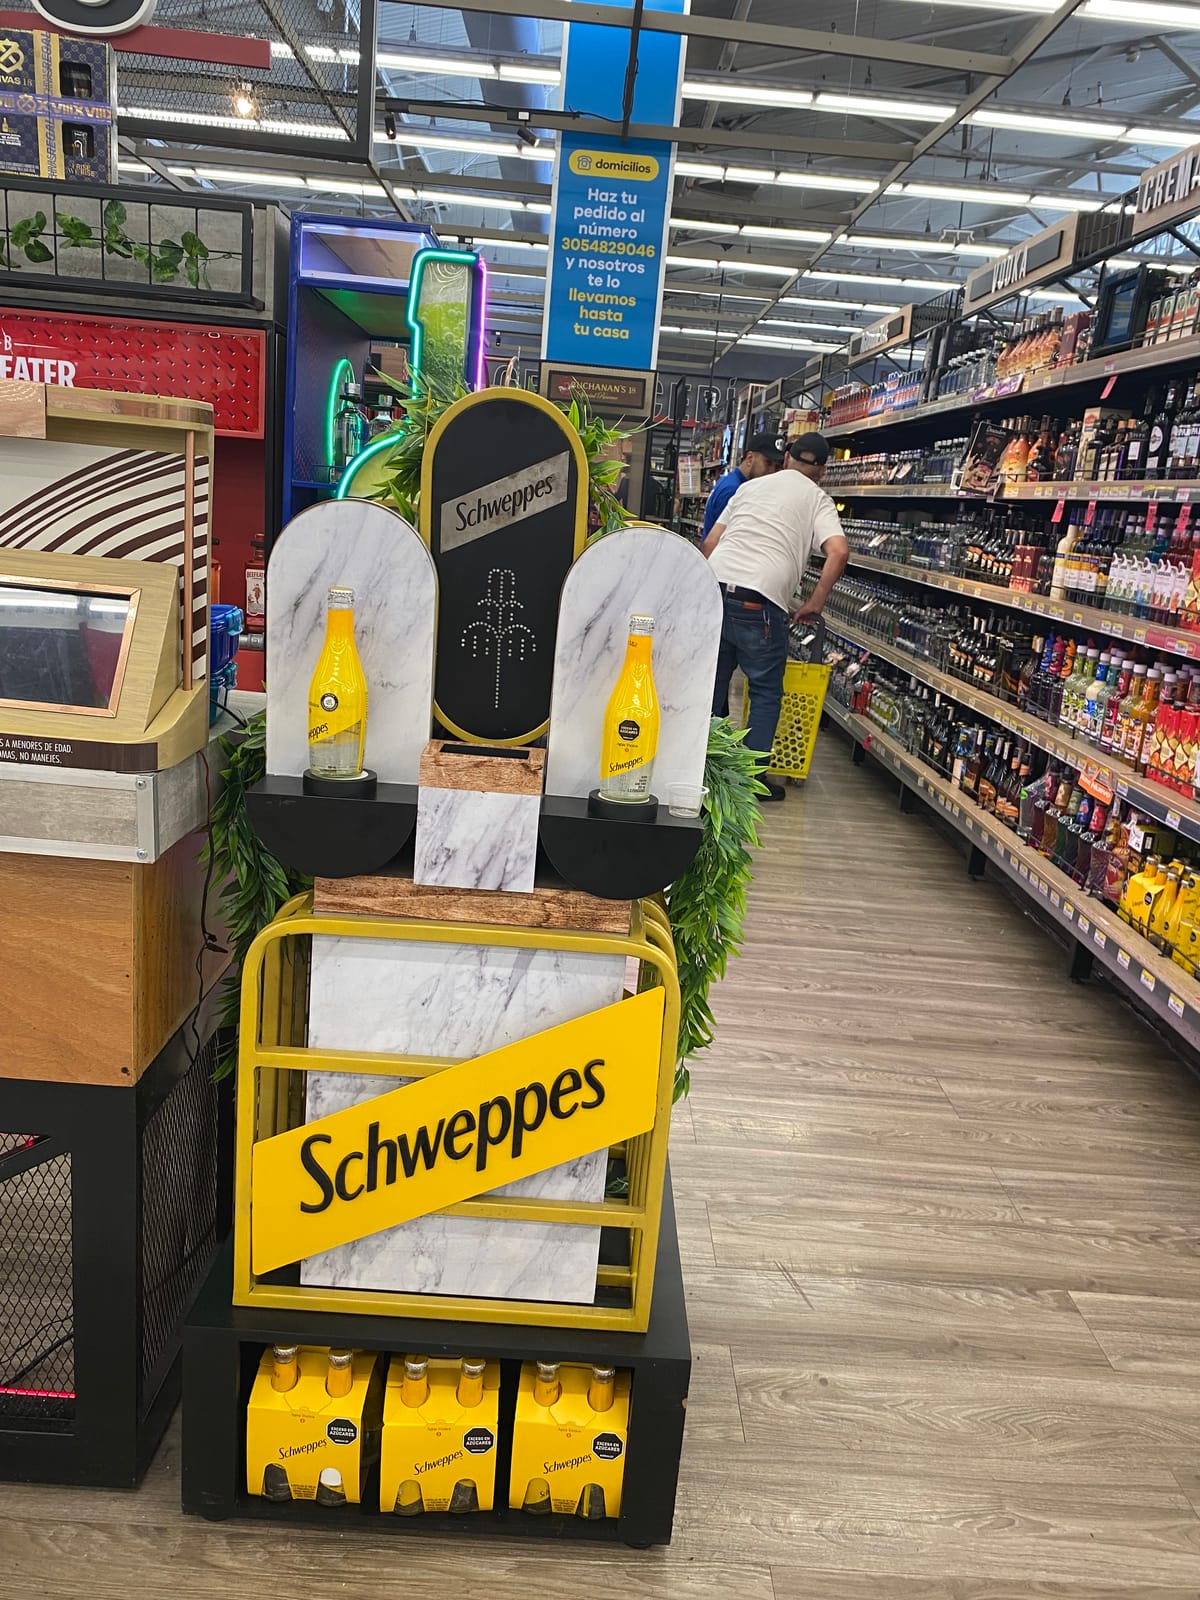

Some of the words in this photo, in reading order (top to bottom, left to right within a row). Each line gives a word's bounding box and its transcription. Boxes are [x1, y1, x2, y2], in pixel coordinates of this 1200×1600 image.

[595, 159, 651, 174] domicilios
[587, 188, 618, 204] Haz
[621, 191, 637, 204] tu
[574, 205, 627, 222] pedido
[630, 209, 645, 222] al
[578, 222, 638, 239] número
[561, 237, 655, 257] 3054829046
[565, 256, 575, 270] y
[578, 257, 645, 273] nosotros
[991, 246, 1028, 293] VODKA
[587, 273, 603, 287] te
[606, 275, 620, 288] lo
[568, 288, 636, 306] llevamos
[579, 305, 623, 322] hasta
[573, 322, 590, 336] tu
[593, 325, 630, 339] casa
[0, 354, 76, 388] EATER
[455, 476, 553, 531] Schweppes
[5, 739, 11, 748] A
[11, 739, 43, 751] MENORES
[44, 743, 53, 752] DE
[54, 743, 74, 754] EDAD.
[19, 752, 29, 761] NO
[31, 753, 62, 764] MANEJES.
[609, 756, 643, 773] Schweppes
[300, 1058, 605, 1214] Schweppes
[279, 1438, 328, 1460] Schweppes
[413, 1449, 464, 1476] Schweppes
[543, 1453, 592, 1475] Schweppes
